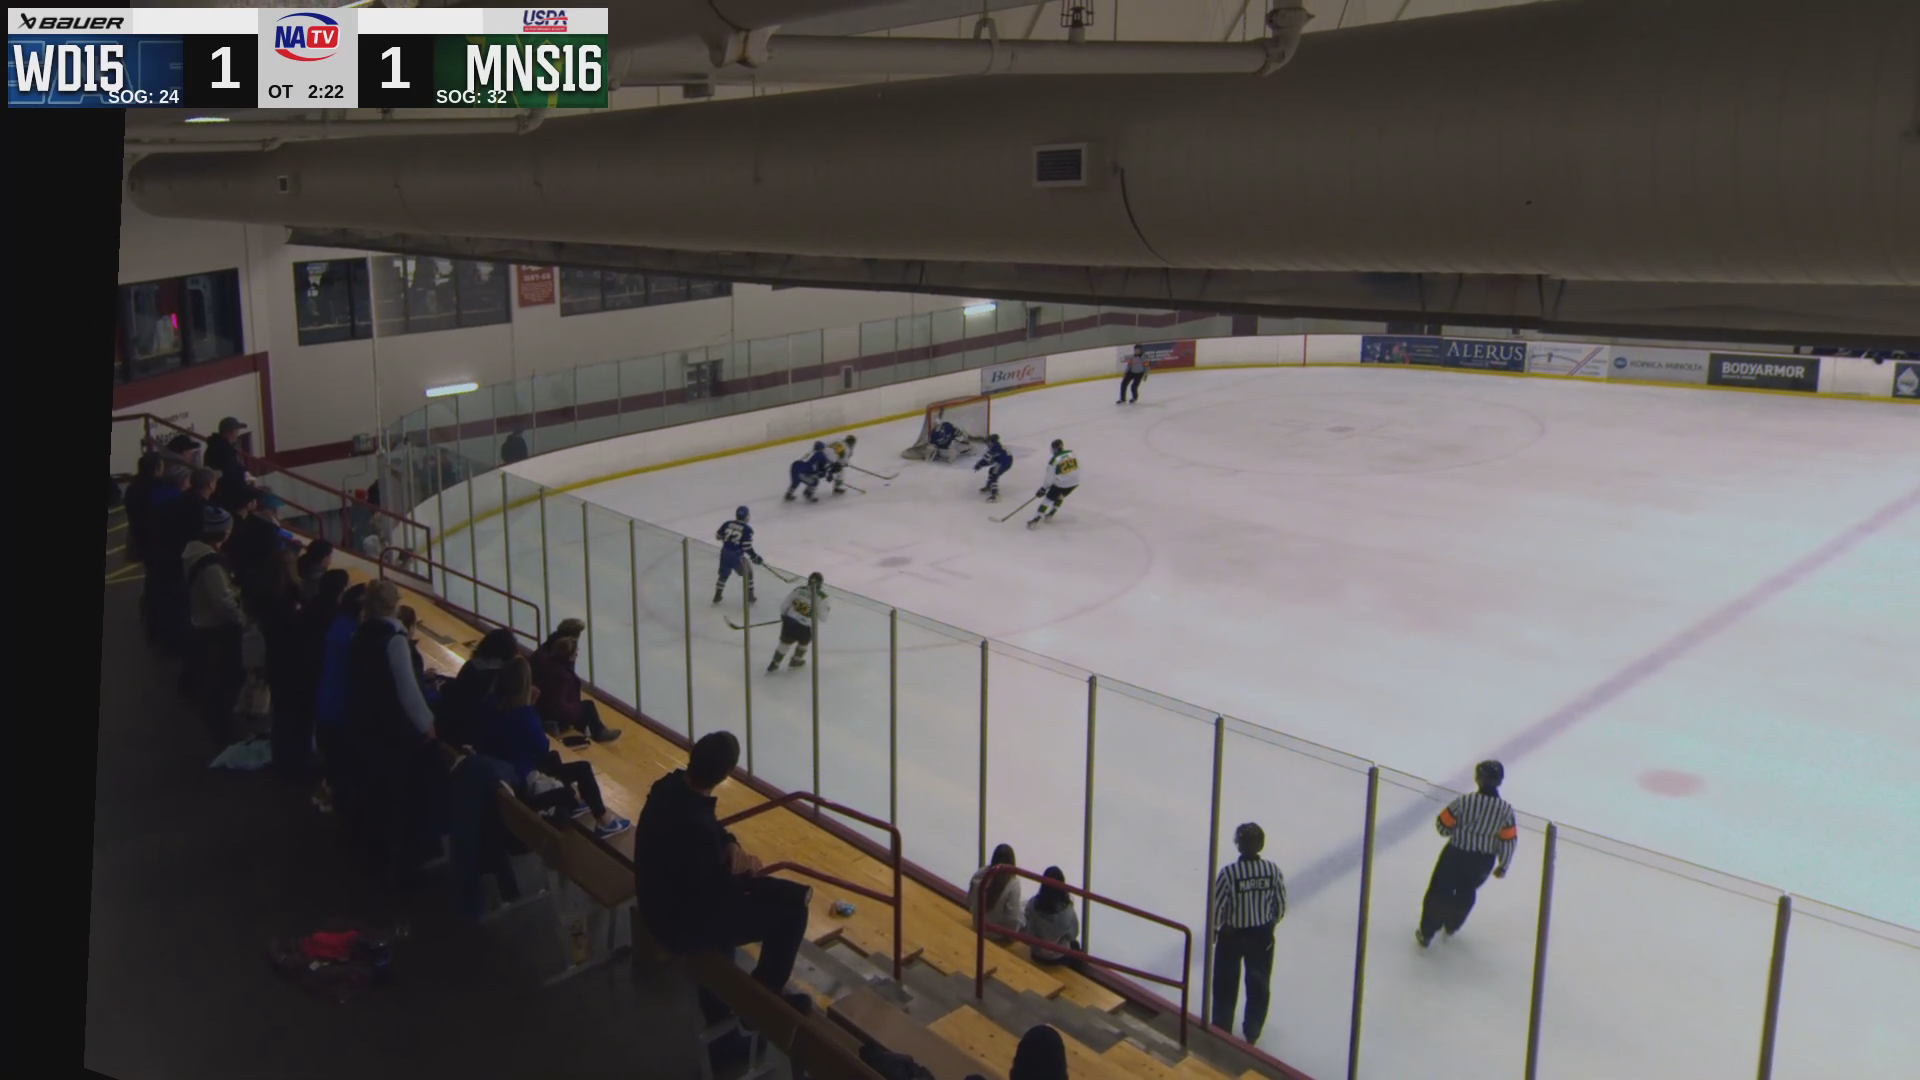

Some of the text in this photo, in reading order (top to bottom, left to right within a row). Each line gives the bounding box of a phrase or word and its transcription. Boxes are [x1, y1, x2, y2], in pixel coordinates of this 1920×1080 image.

[1446, 340, 1524, 361] ALERUS
[991, 364, 1035, 383] Bonfe
[1722, 361, 1805, 379] BODYARMOR
